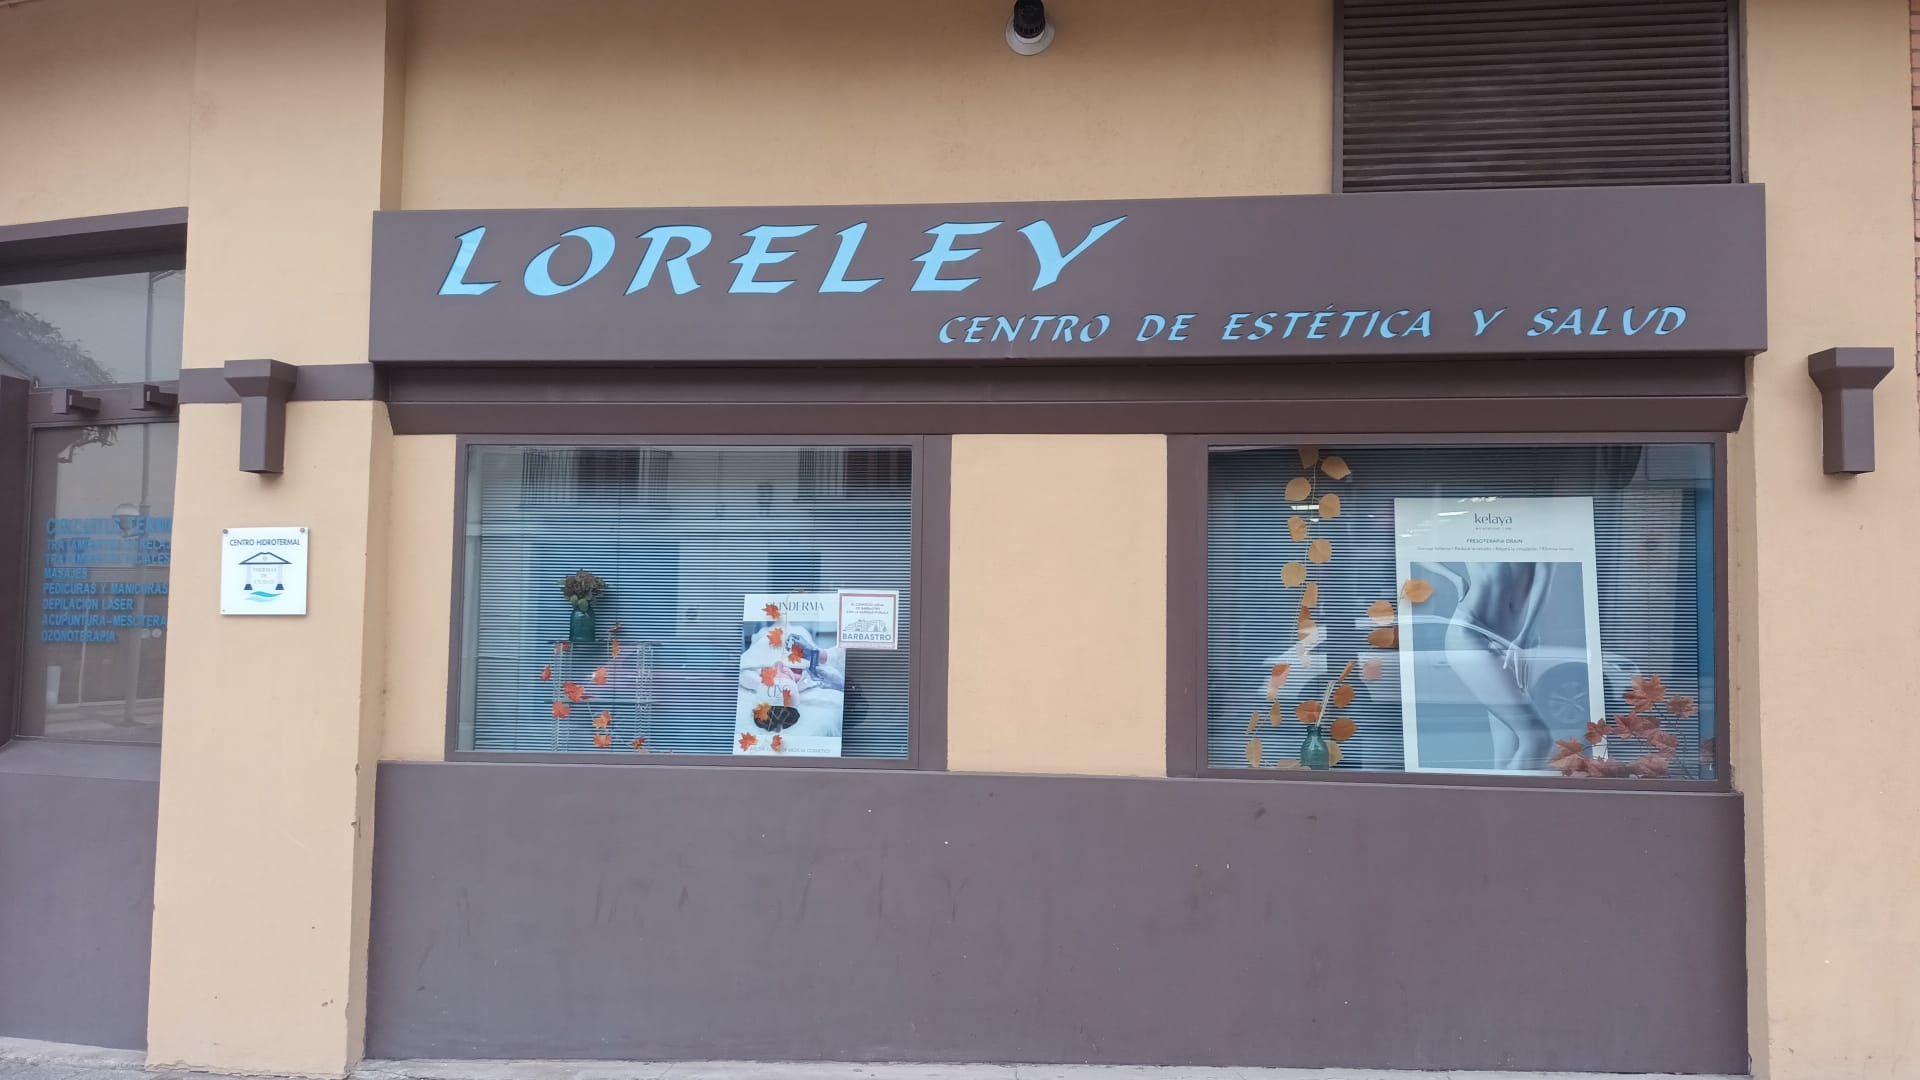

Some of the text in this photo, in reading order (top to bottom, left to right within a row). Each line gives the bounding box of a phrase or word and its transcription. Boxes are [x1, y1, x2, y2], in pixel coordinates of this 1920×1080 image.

[437, 215, 1127, 296] LORELEY
[938, 304, 1687, 344] CENTRO DE ESTÉTICA Y SALUD
[1474, 512, 1513, 526] kelaya
[229, 538, 300, 546] CENTRO HIDROTERMAL
[44, 567, 88, 579] MASAJES
[44, 582, 169, 594] PEDICURAS Y MANICURAS
[43, 598, 134, 610] DEPILACION LASER
[767, 600, 824, 612] INDERMA
[842, 633, 892, 641] BARBASTRO
